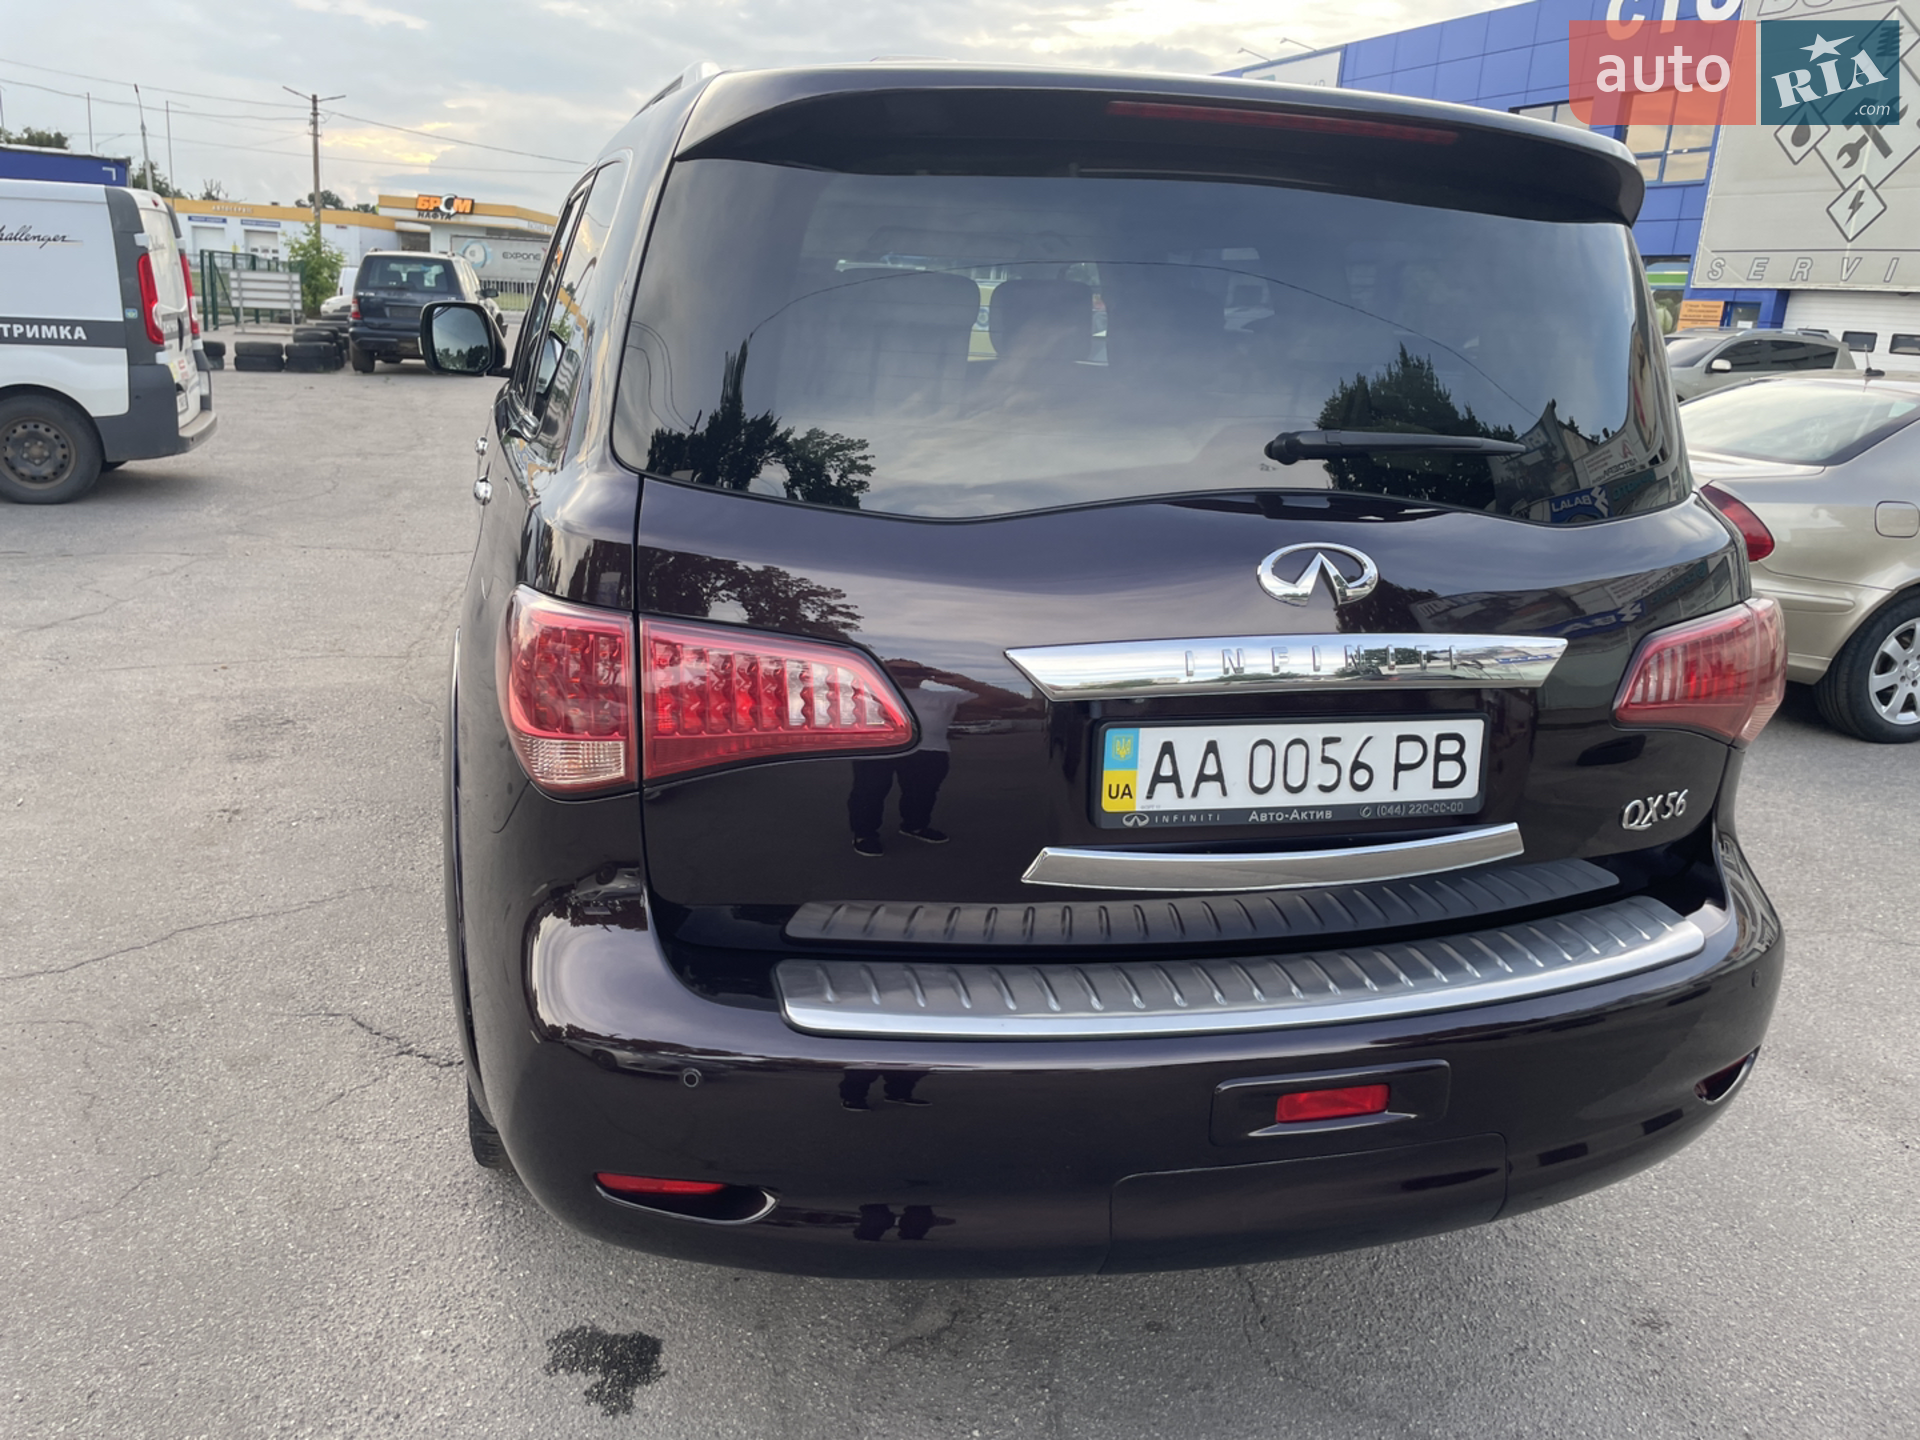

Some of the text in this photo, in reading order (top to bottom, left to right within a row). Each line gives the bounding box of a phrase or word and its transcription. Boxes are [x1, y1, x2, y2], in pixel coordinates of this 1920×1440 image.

[418, 211, 452, 221] НАФТА
[1707, 257, 1899, 283] SERVI
[1184, 644, 1458, 678] INFINITI
[1146, 732, 1467, 800] AA 0056 PB
[1108, 784, 1133, 799] UA
[1155, 814, 1220, 823] INFINITI
[1622, 788, 1689, 831] QX56
